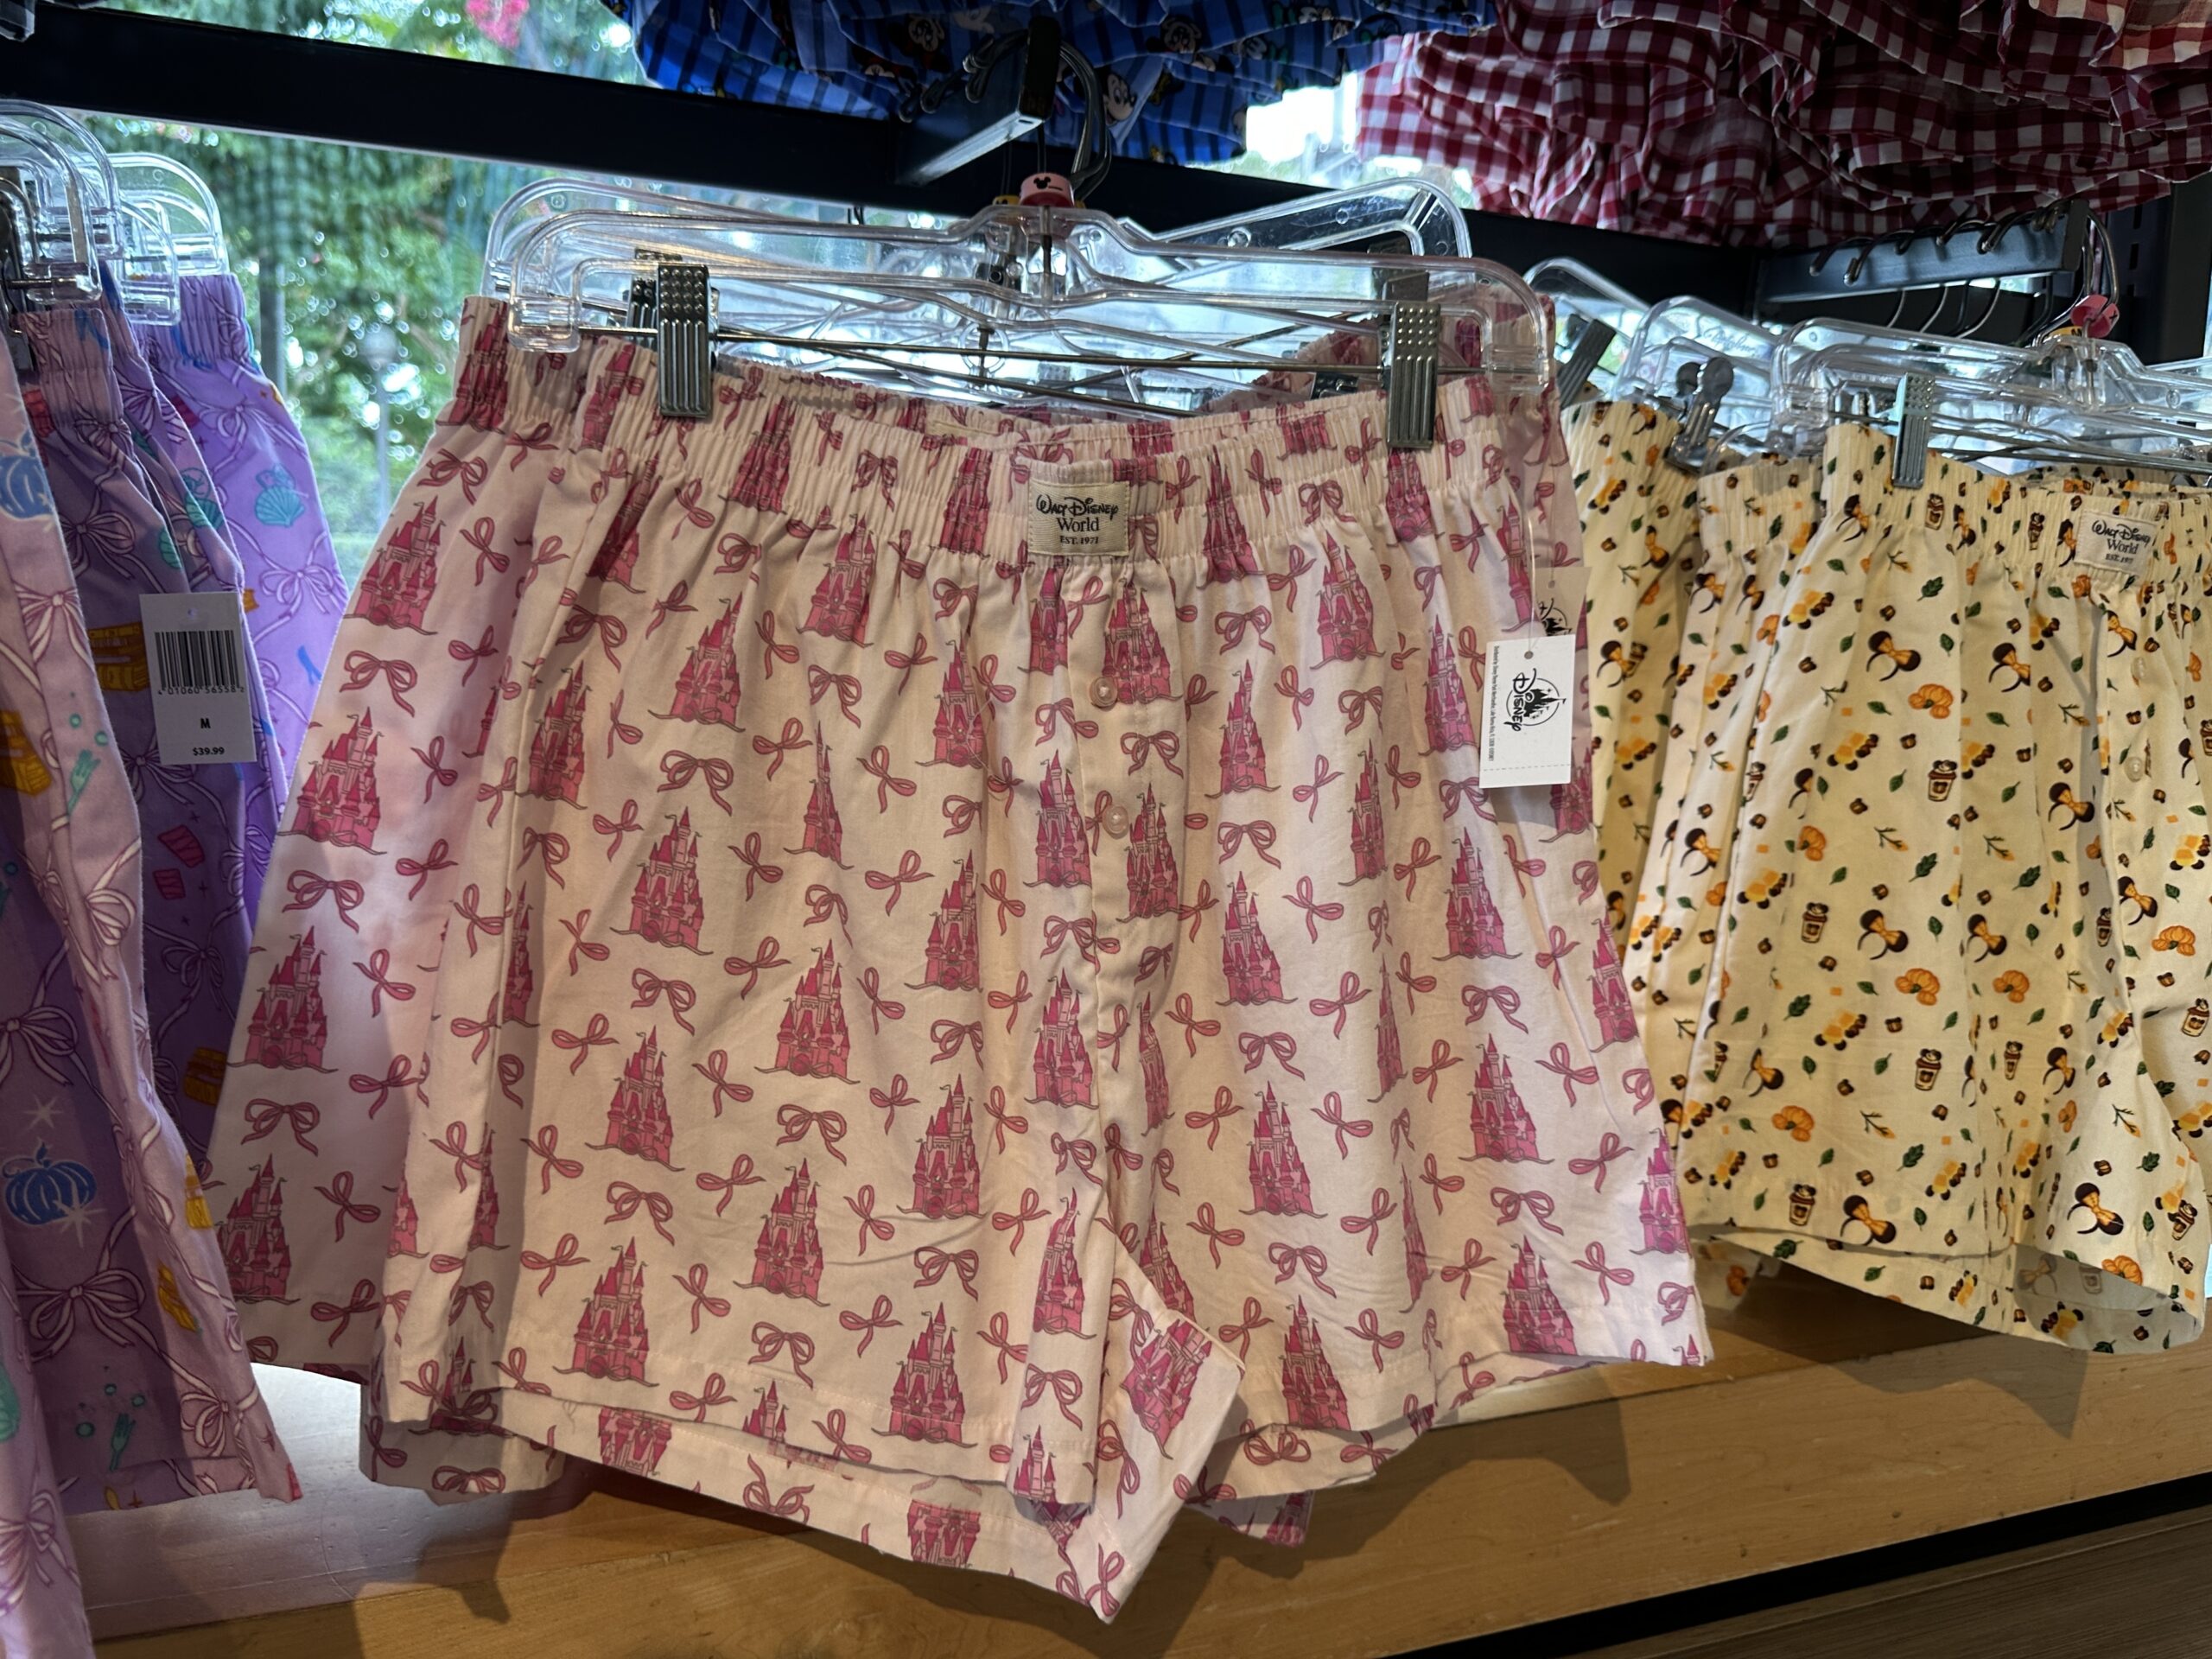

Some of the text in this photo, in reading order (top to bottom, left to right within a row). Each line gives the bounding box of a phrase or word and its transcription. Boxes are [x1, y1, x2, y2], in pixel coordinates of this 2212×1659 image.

[1036, 493, 1119, 520] Walt Disney
[1056, 517, 1099, 532] World
[1059, 535, 1099, 545] EST. 1971
[2107, 538, 2139, 555] World
[205, 685, 236, 694] 56558
[1503, 667, 1537, 732] Disney
[200, 717, 211, 729] M
[193, 747, 225, 757] $39.99
